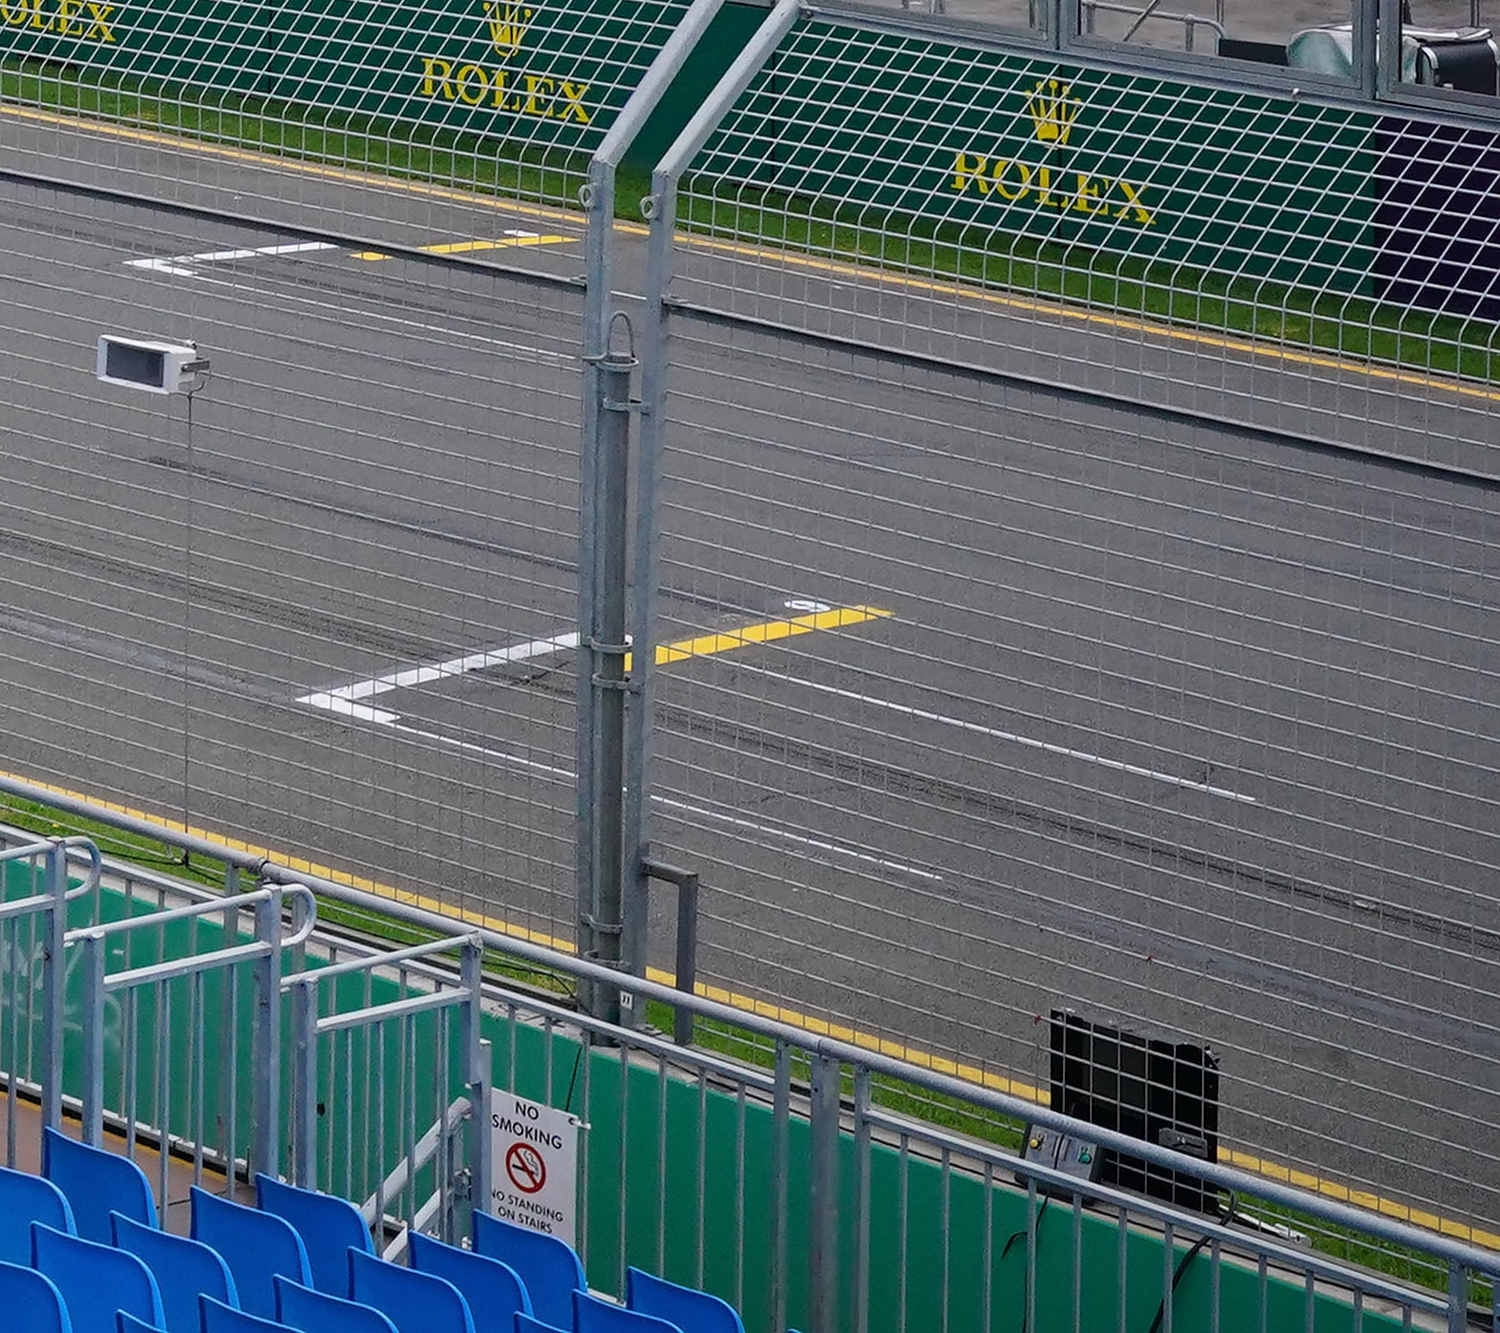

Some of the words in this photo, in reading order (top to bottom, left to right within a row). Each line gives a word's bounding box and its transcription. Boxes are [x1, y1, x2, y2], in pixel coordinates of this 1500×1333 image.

[420, 58, 591, 124] ROLEX
[951, 152, 1156, 225] ROLEX
[515, 1101, 539, 1120] NO
[492, 1114, 562, 1149] SMOKING
[498, 1207, 515, 1220] ON
[518, 1213, 552, 1233] STAIRS
[508, 1195, 564, 1223] STANDING
